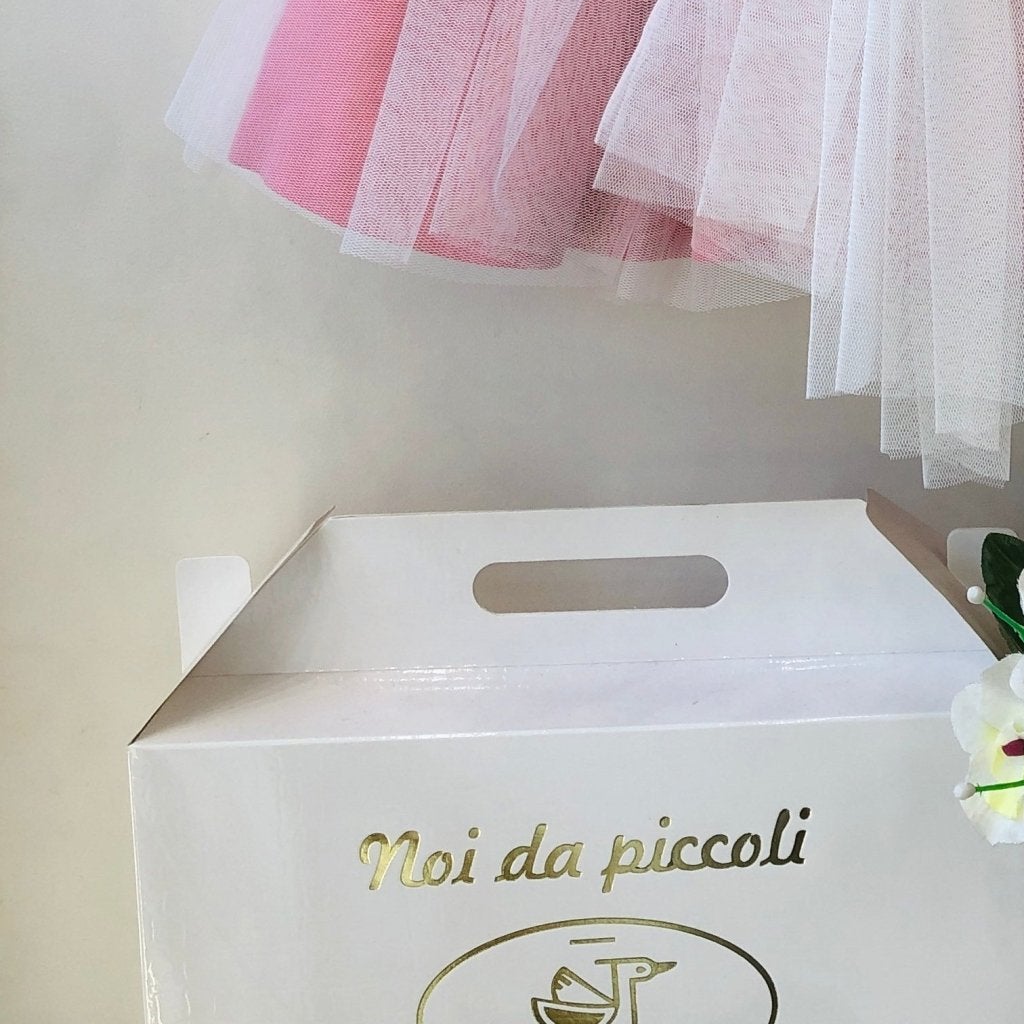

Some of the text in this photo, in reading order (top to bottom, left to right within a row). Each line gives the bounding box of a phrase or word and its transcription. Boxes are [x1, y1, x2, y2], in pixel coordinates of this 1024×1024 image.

[359, 807, 812, 894] Noi da piccoli
